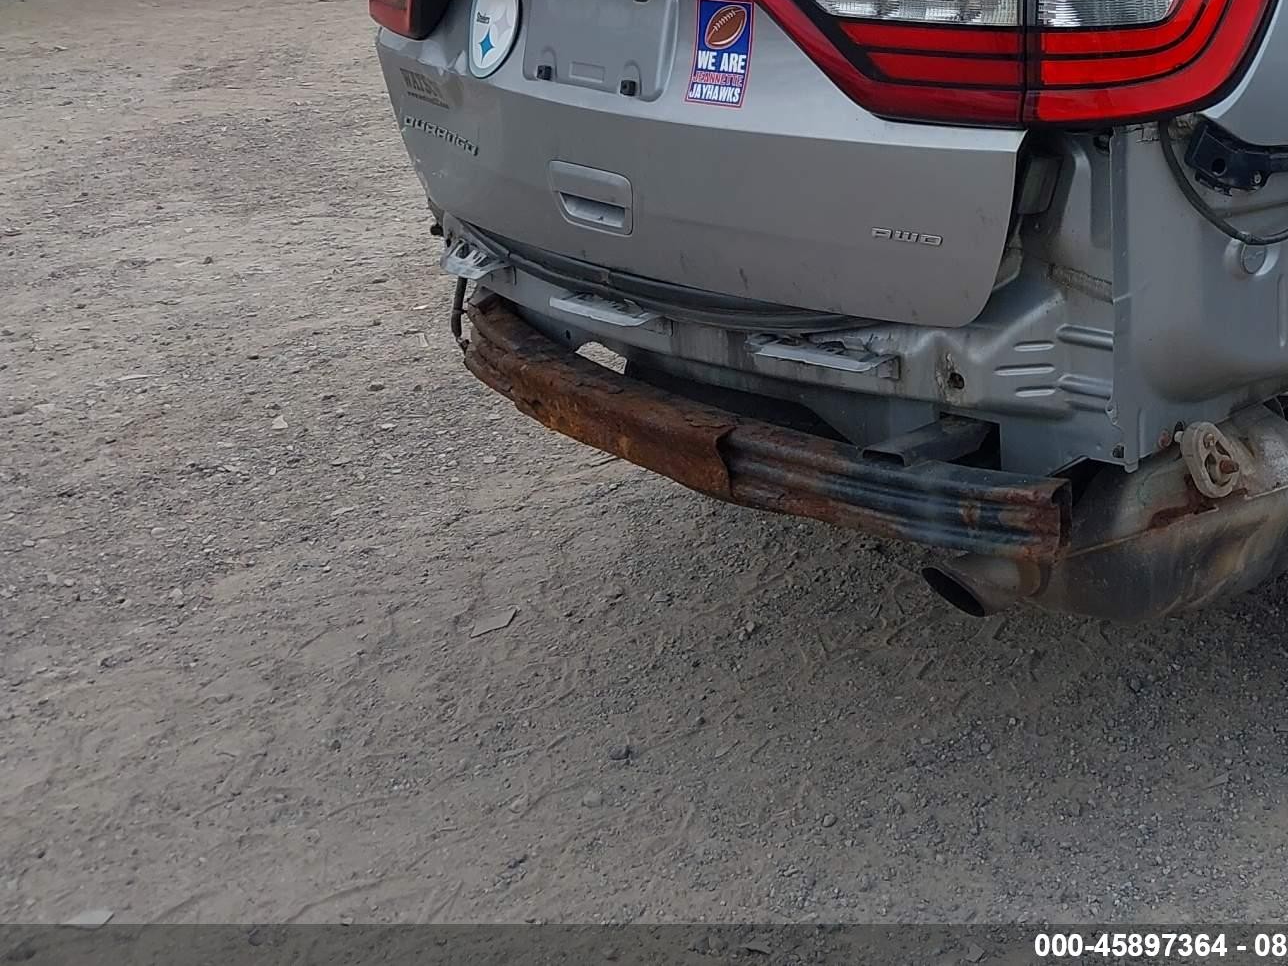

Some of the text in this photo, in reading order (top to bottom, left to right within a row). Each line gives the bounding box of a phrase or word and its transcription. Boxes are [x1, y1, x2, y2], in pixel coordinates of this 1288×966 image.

[697, 50, 747, 74] WE ARE
[692, 71, 743, 87] JEANNETTE
[688, 83, 741, 103] JAYHAWKS
[403, 115, 479, 156] DURANGO
[871, 227, 944, 246] AWD
